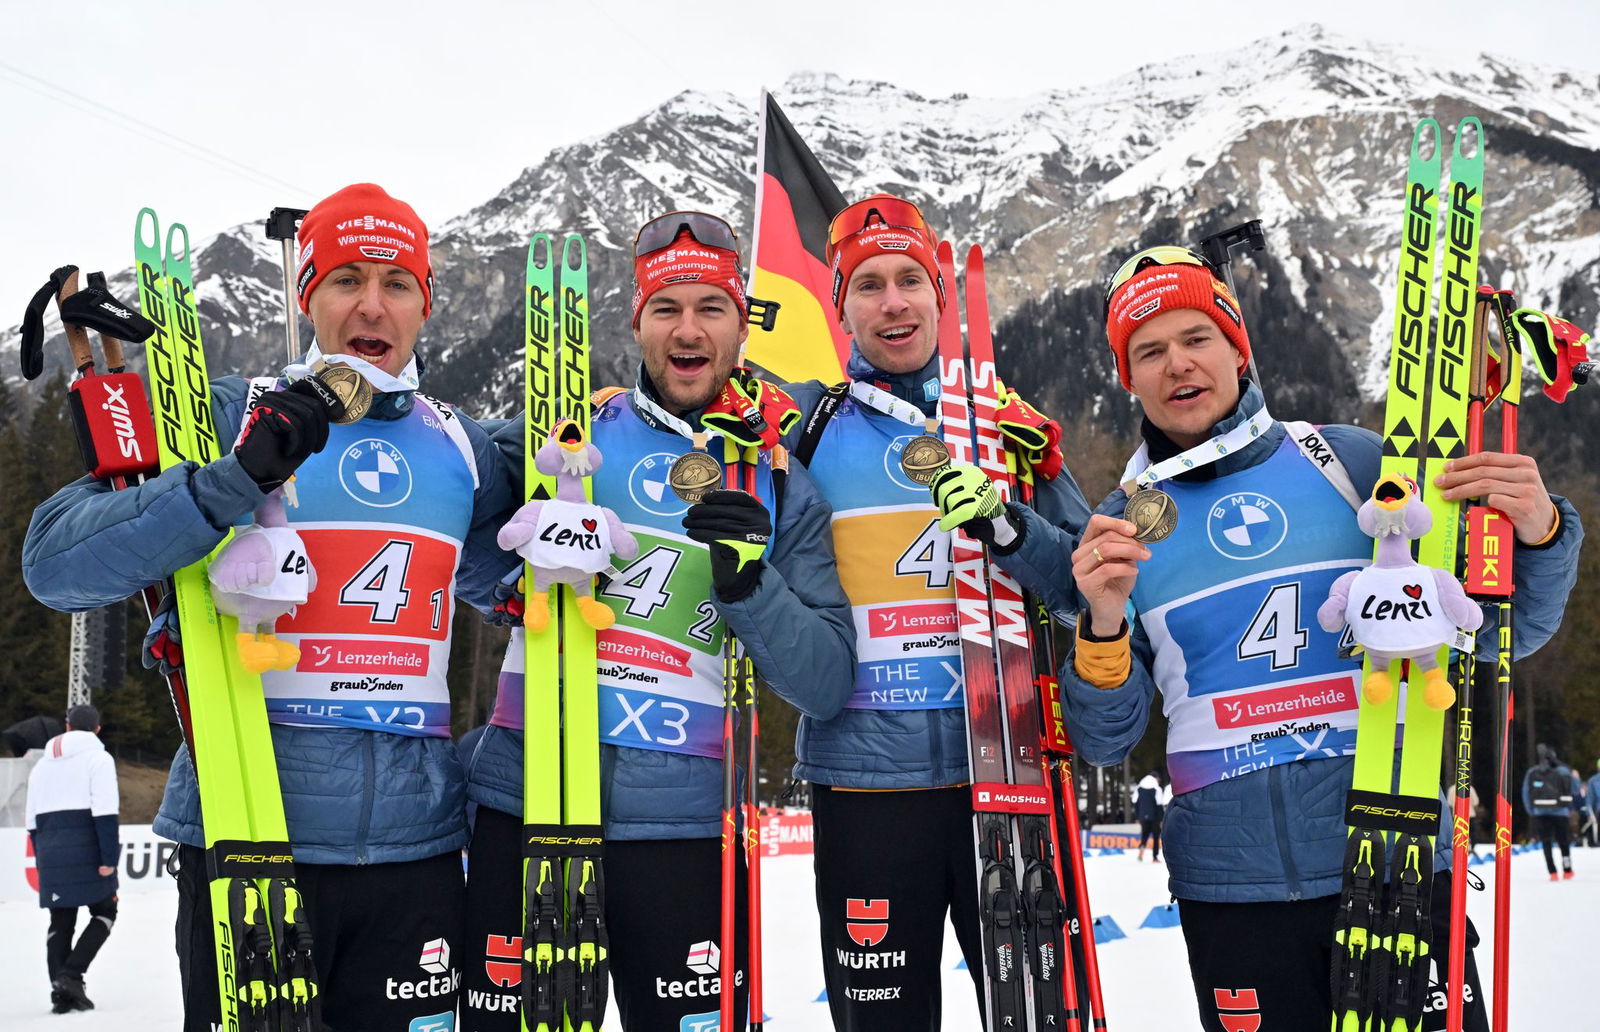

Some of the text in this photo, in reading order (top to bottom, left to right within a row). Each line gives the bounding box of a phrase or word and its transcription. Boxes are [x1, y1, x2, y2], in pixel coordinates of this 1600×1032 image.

[336, 215, 415, 239] VIESSMANN
[338, 234, 415, 253] Wärmepumpen
[646, 249, 719, 268] VIESSMANN
[647, 262, 718, 280] Wärmepumpen
[1395, 182, 1434, 400] FISCHER
[1438, 181, 1477, 400] FISCHER
[142, 262, 187, 461] FISCHER
[172, 276, 215, 464] FISCHER
[348, 405, 364, 420] IBU
[349, 441, 401, 462] BMW
[1299, 433, 1332, 467] JOKA
[685, 493, 701, 501] IBU
[1213, 495, 1271, 520] BMW
[1154, 525, 1168, 539] IBU
[895, 517, 953, 588] 4
[1481, 514, 1499, 586] LEKI
[338, 539, 443, 631] 4 1
[600, 543, 721, 644] 4 2
[1237, 581, 1309, 672] 4
[337, 650, 422, 668] Lenzerheide
[869, 664, 921, 682] THE
[871, 687, 928, 703] NEW
[1248, 692, 1346, 717] Lenzerheide
[608, 693, 690, 746] X3
[1049, 682, 1066, 745] LEKI
[994, 794, 1047, 804] MADSHUS
[1350, 804, 1438, 822] FISCHER
[528, 836, 603, 845] FISCHER
[224, 854, 293, 864] FISCHER
[837, 948, 906, 969] WÜRTH
[219, 921, 239, 1032] FISCHE
[386, 967, 462, 1000] tectak
[656, 969, 744, 998] tectae
[468, 989, 522, 1014] WÜR
[851, 986, 901, 1001] TERREX
